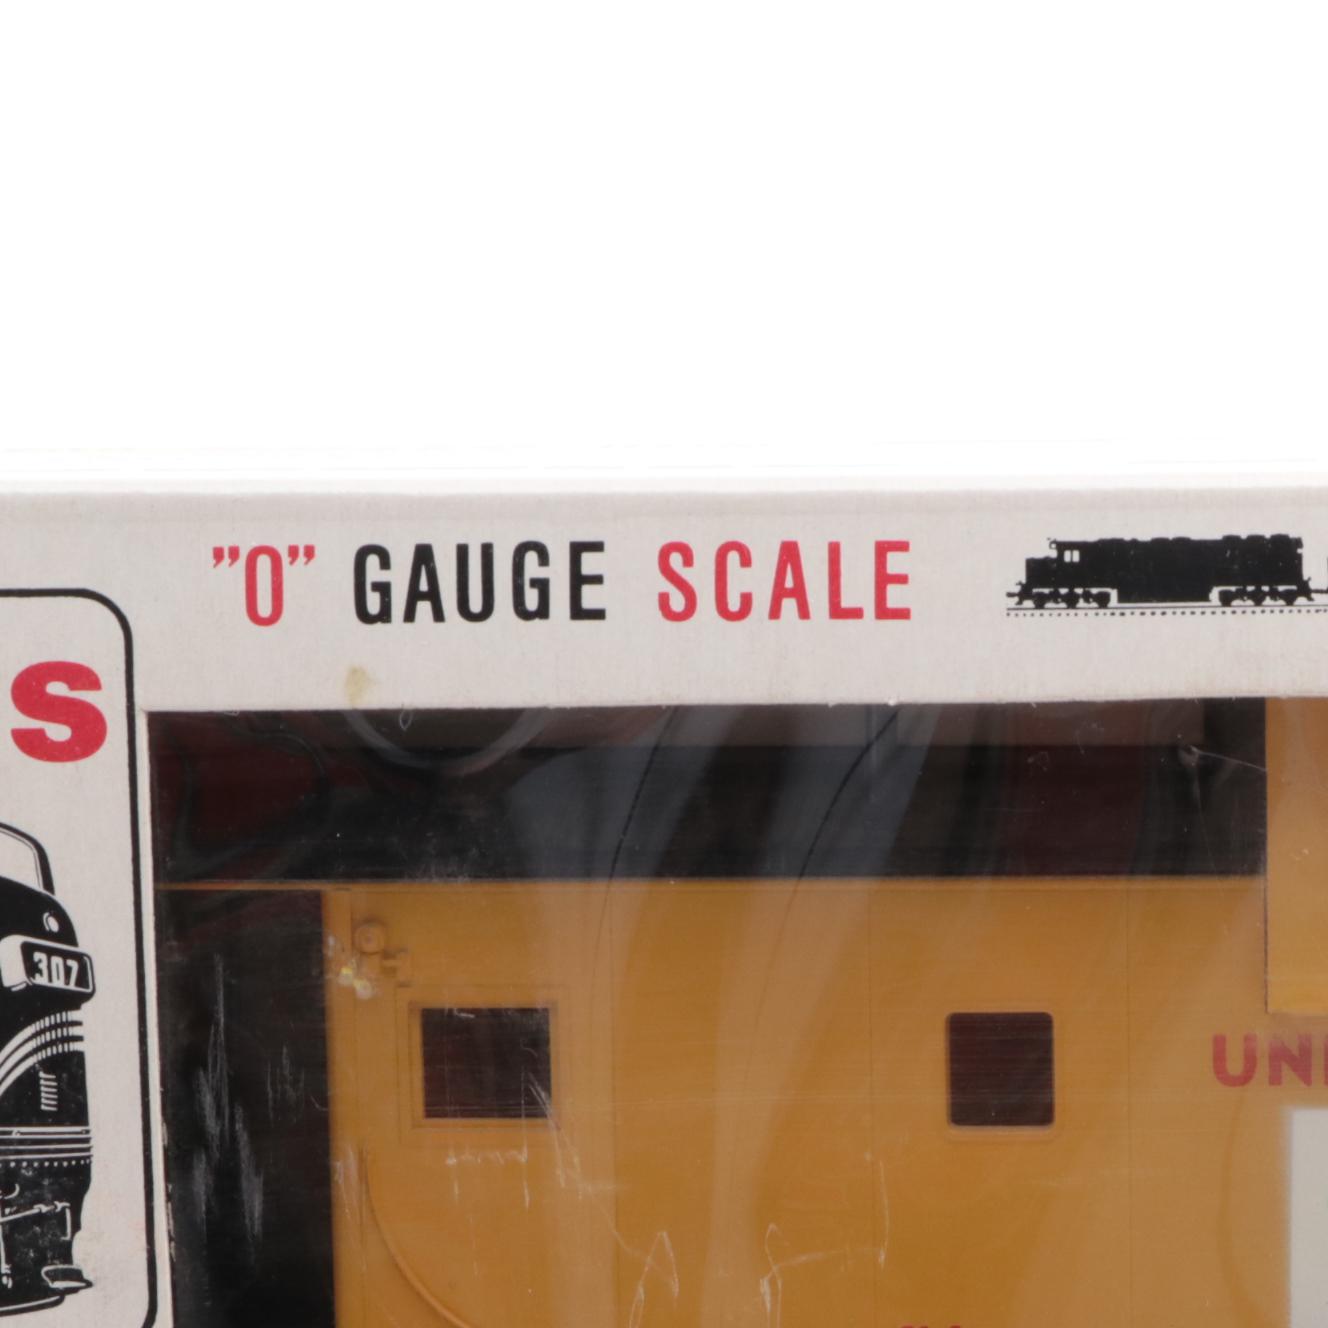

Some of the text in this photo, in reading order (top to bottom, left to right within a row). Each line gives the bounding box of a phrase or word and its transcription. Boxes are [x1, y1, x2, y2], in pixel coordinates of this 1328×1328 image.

[353, 541, 607, 626] GAUGE
[658, 540, 912, 622] SCALE
[33, 951, 79, 988] 307
